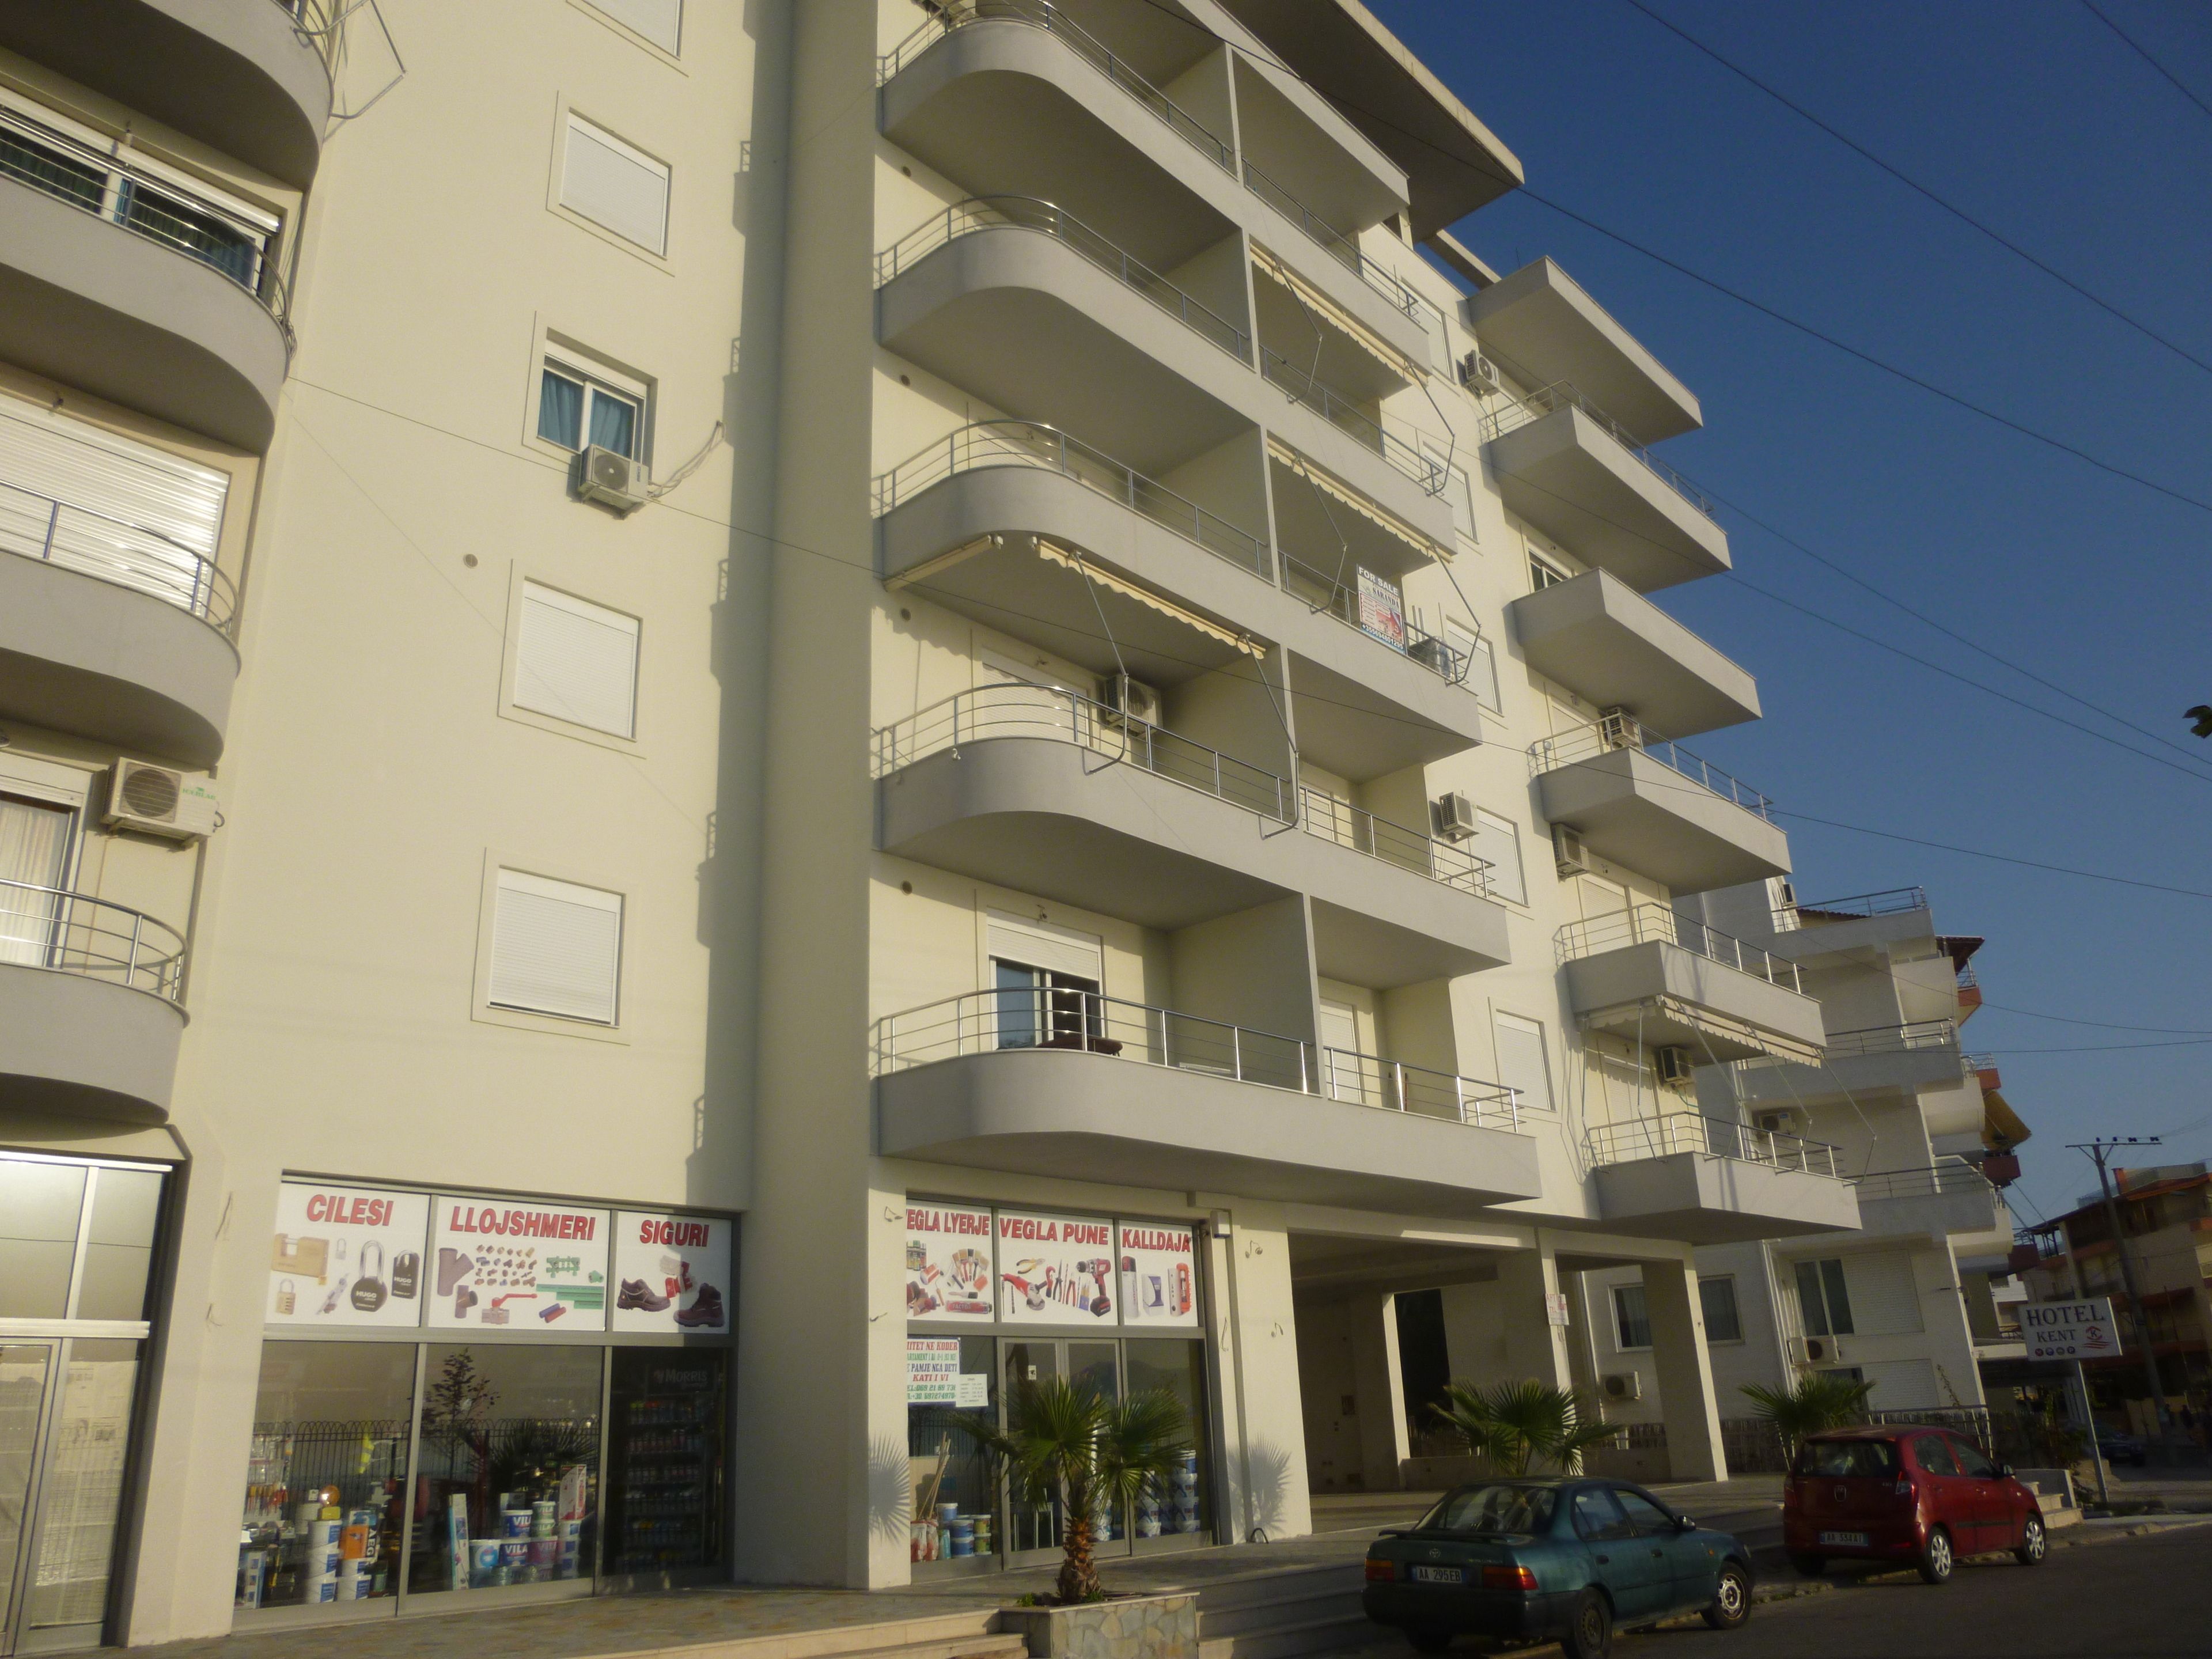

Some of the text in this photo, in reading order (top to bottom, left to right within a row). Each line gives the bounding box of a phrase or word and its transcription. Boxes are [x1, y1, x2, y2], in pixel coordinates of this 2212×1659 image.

[1358, 566, 1376, 583] FOR
[1378, 578, 1399, 596] SALE
[306, 1194, 394, 1226] CILESI
[450, 1206, 596, 1241] LLOJSHMERI
[639, 1219, 710, 1247] SIGURI
[906, 1209, 990, 1236] EGLA LYERJE
[999, 1217, 1109, 1245] VEGLA PUNE
[1122, 1228, 1191, 1252] KALLDAJA
[2026, 1304, 2105, 1327] HOTEL
[926, 1342, 935, 1350] NE
[936, 1342, 957, 1350] KODER
[2036, 1330, 2076, 1342] KENT
[665, 1369, 707, 1383] MORRIS
[911, 1363, 931, 1372] PAMJE
[932, 1363, 942, 1372] NGA
[945, 1363, 957, 1372] DETI
[366, 1528, 377, 1556] AEG
[505, 1544, 528, 1554] VILA
[1419, 1568, 1461, 1582] AA 295EB
